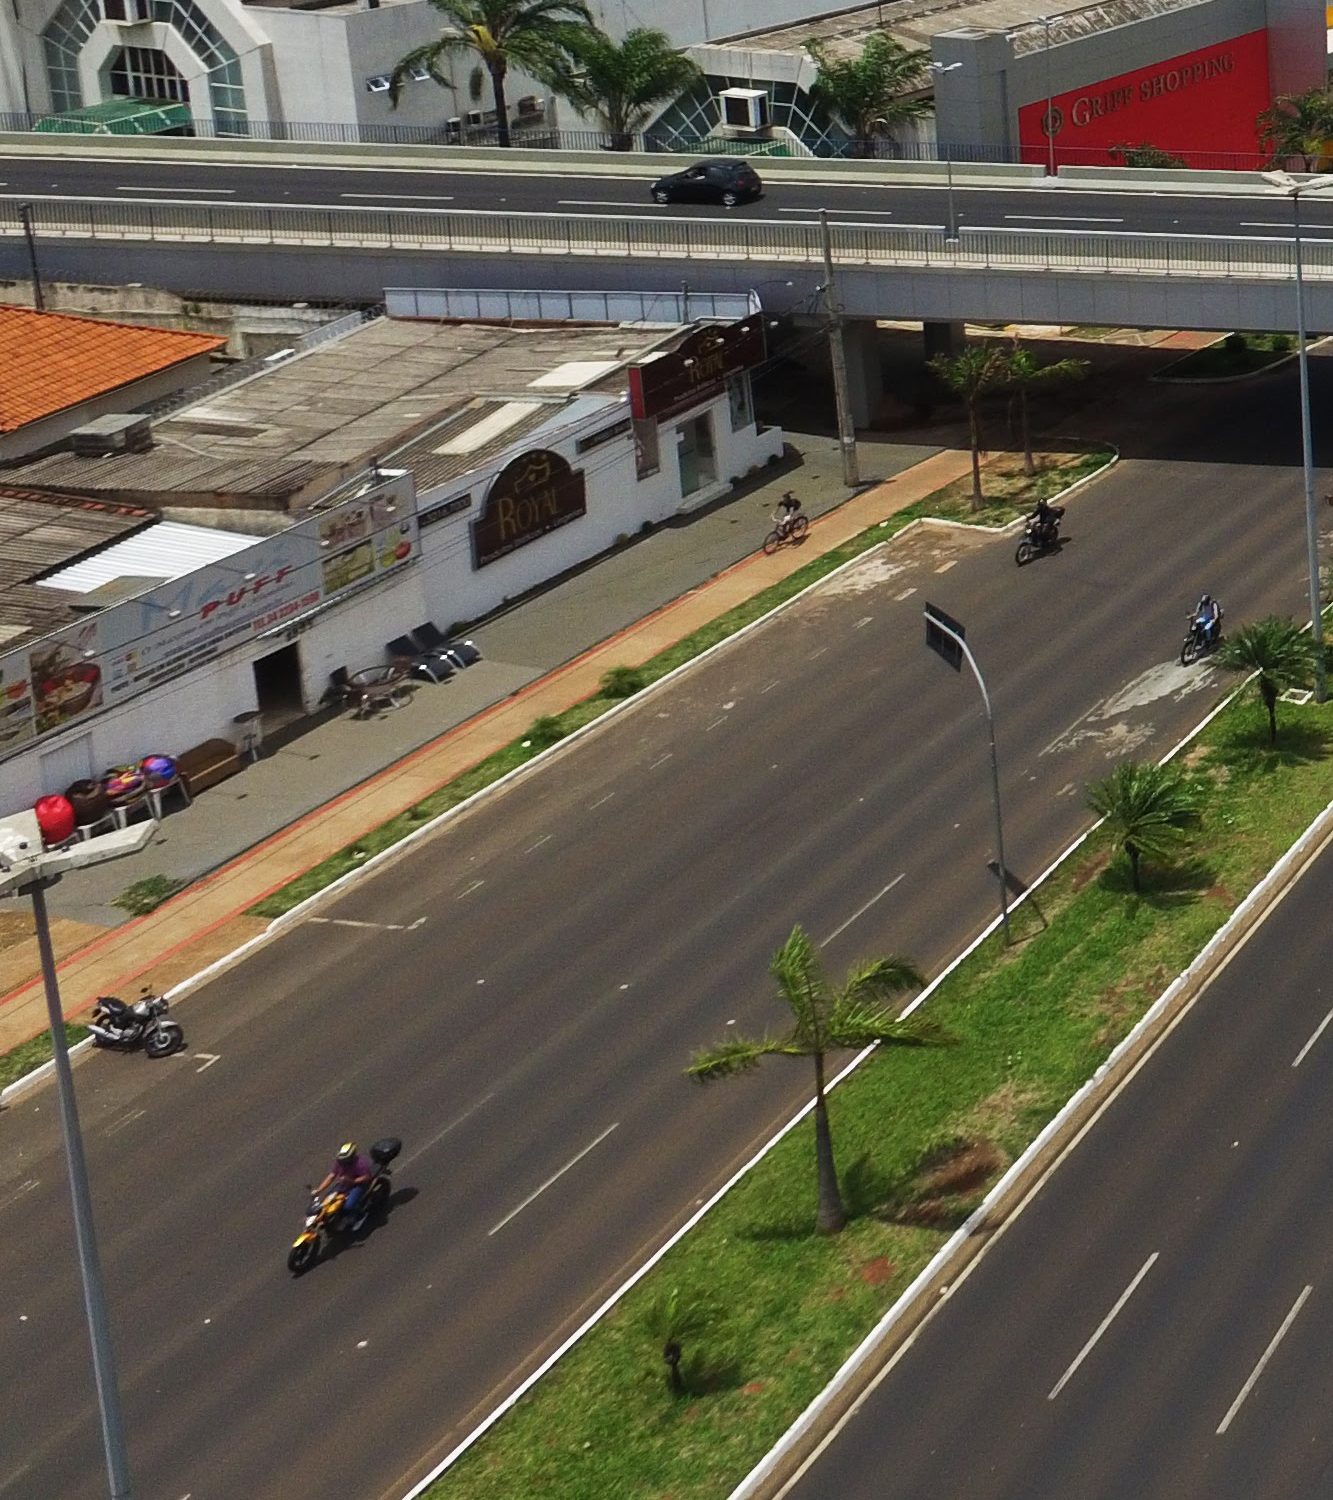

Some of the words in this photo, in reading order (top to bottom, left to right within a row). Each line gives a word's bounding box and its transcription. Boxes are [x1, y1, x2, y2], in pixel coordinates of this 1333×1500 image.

[1072, 86, 1133, 127] GRIFF
[1139, 52, 1235, 102] SHOPPING
[499, 486, 557, 541] ROYAL
[201, 564, 292, 619] PUFF
